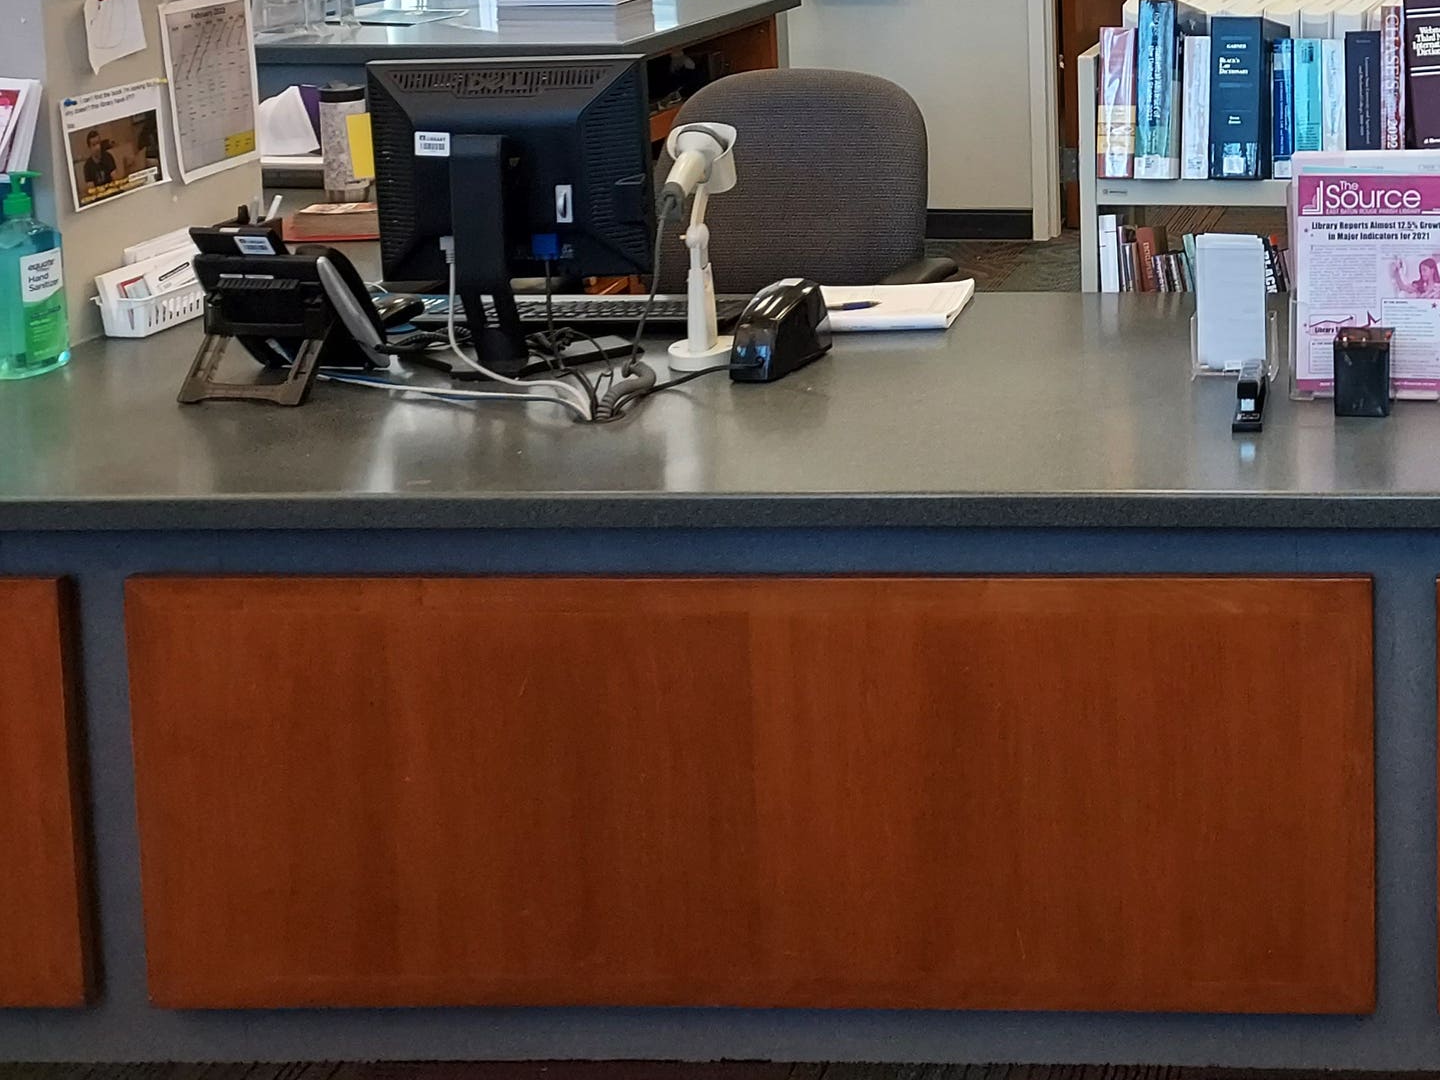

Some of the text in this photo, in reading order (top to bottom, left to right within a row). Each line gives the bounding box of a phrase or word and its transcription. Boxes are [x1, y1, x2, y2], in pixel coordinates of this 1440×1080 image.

[1415, 34, 1436, 42] Third
[1387, 119, 1398, 149] 2022
[1339, 180, 1359, 190] The
[1325, 185, 1421, 209] Source
[1312, 221, 1337, 230] Library
[1339, 221, 1368, 230] Reports
[1370, 221, 1396, 230] Almost
[1397, 221, 1418, 229] 12.5%
[1328, 231, 1430, 241] in Major Indicators for 2021
[28, 273, 49, 283] Hand
[28, 279, 59, 292] Sanitizer
